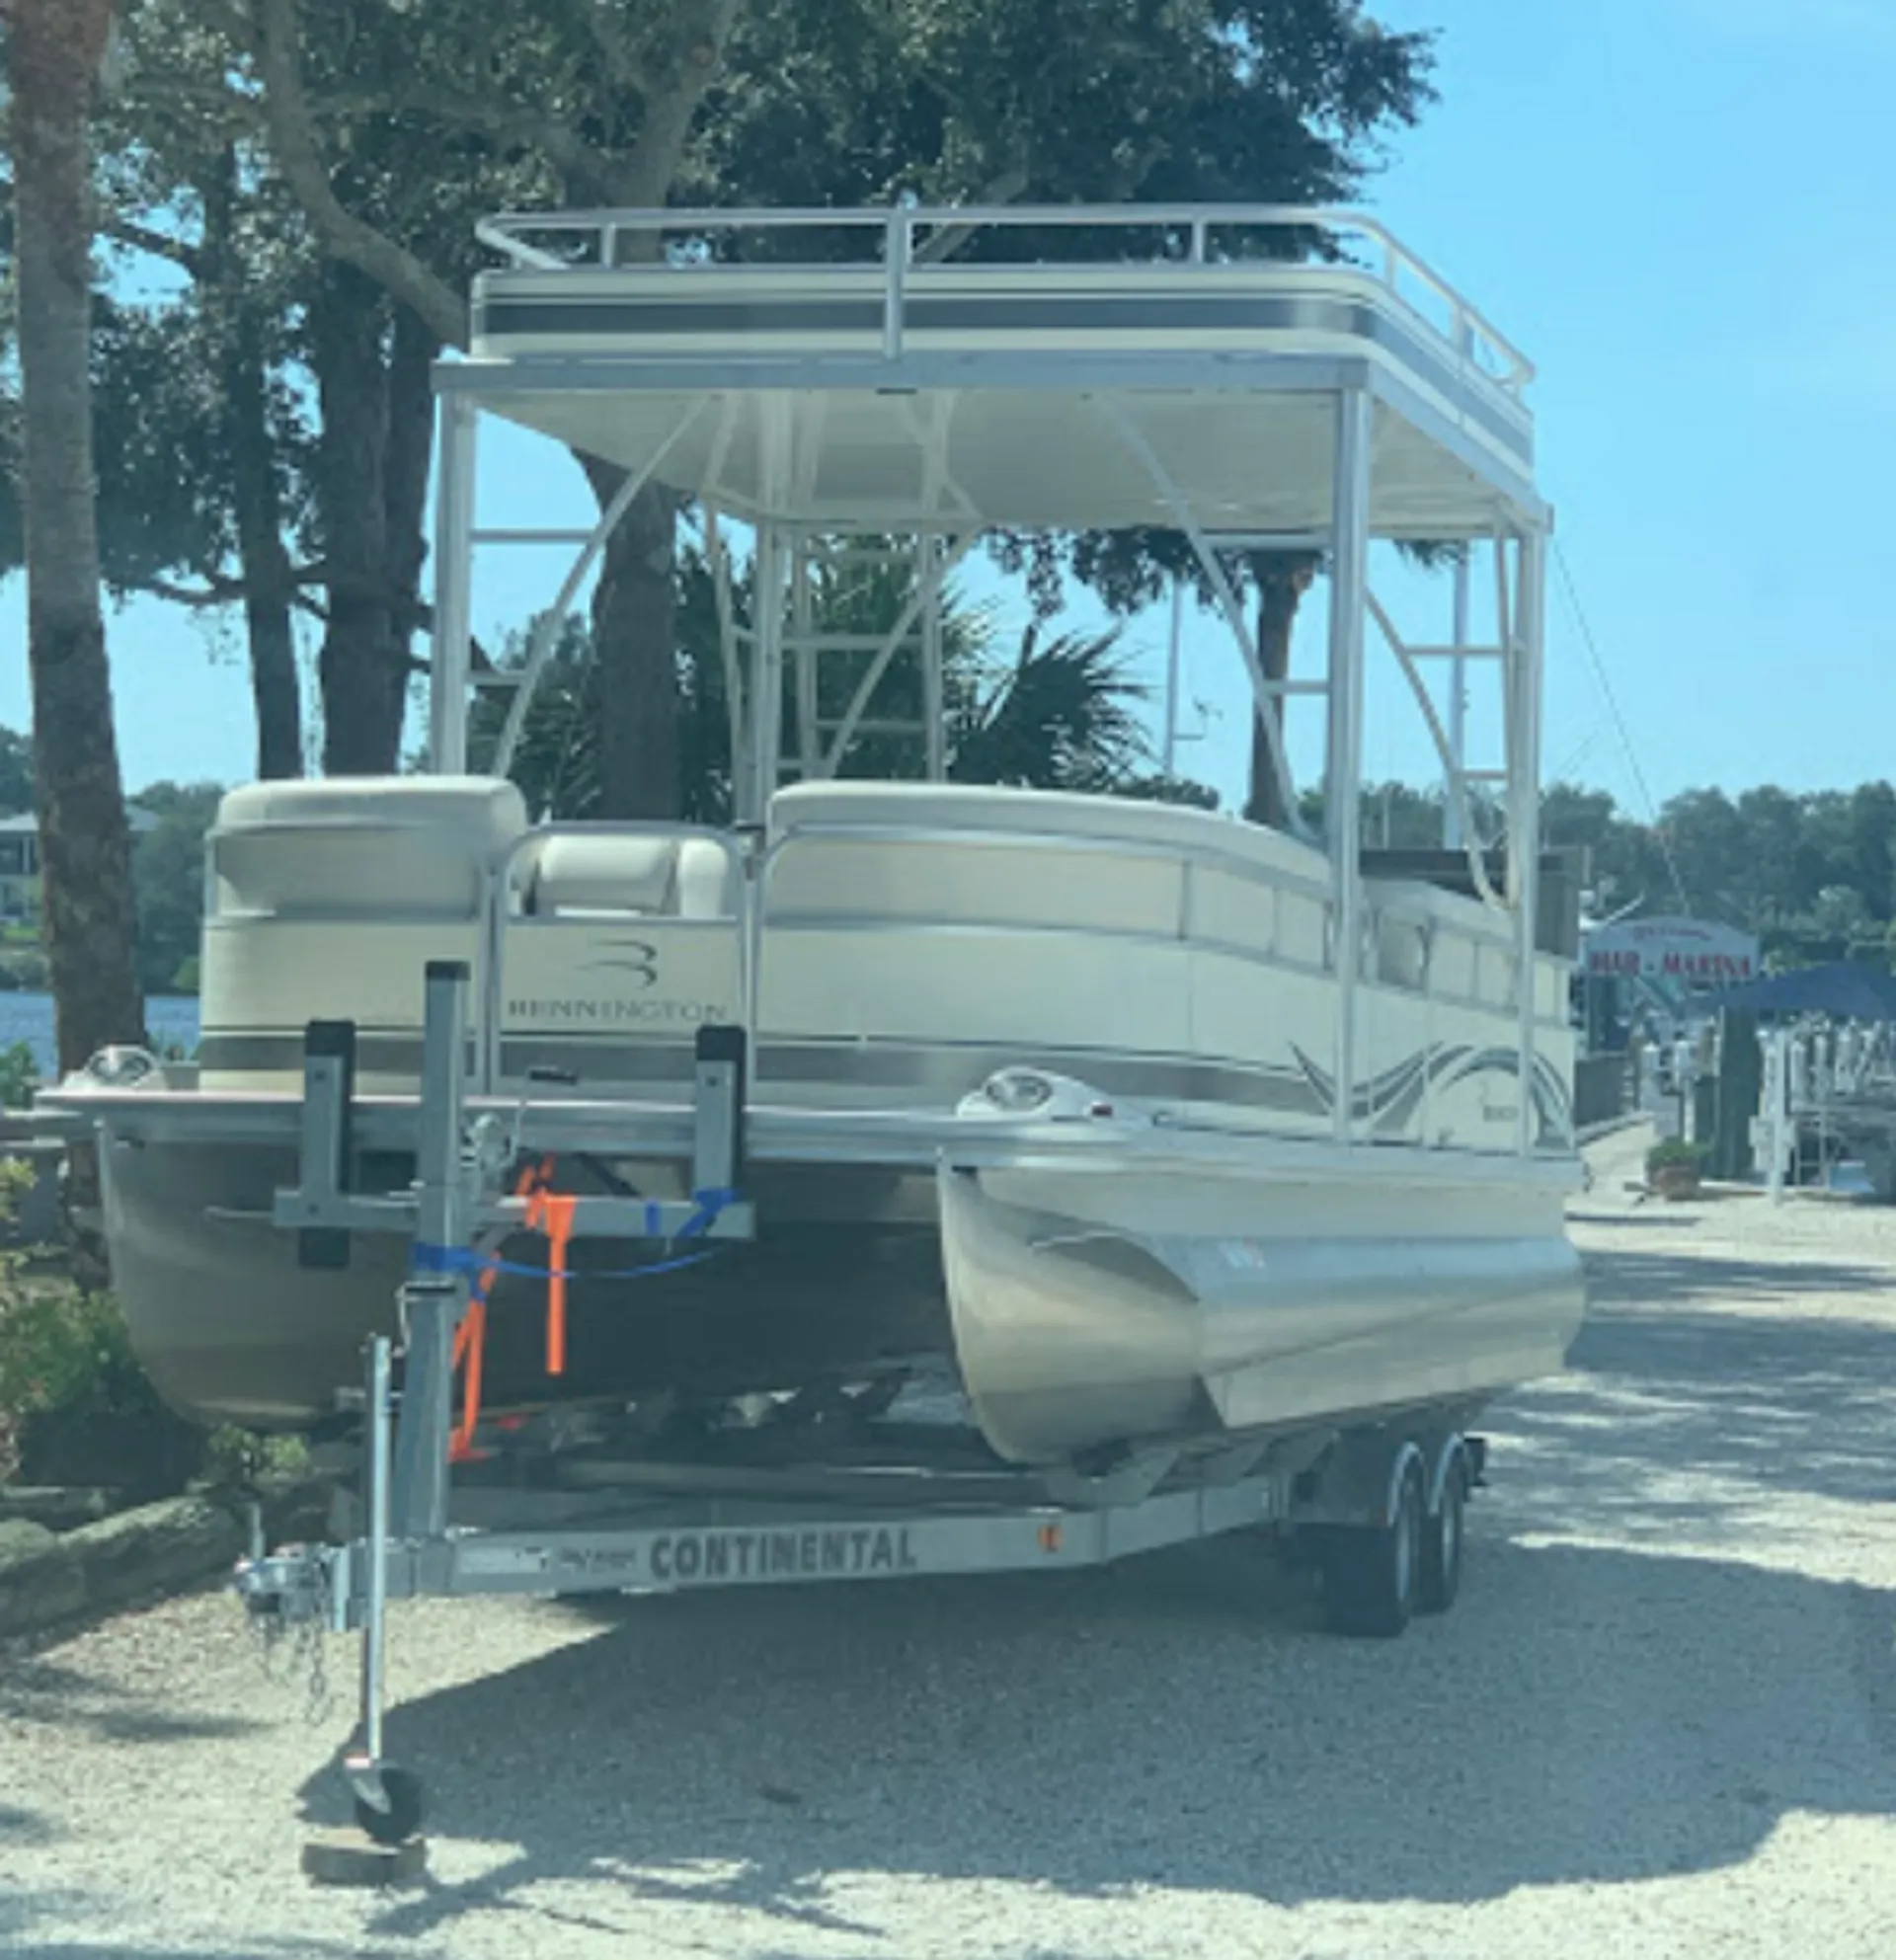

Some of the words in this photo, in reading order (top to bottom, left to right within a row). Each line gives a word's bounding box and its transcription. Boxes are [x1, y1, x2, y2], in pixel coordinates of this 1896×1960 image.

[1663, 951, 1752, 977] MARINA
[508, 998, 728, 1021] BENNINGTON
[650, 1529, 917, 1580] CONTINENTAL
